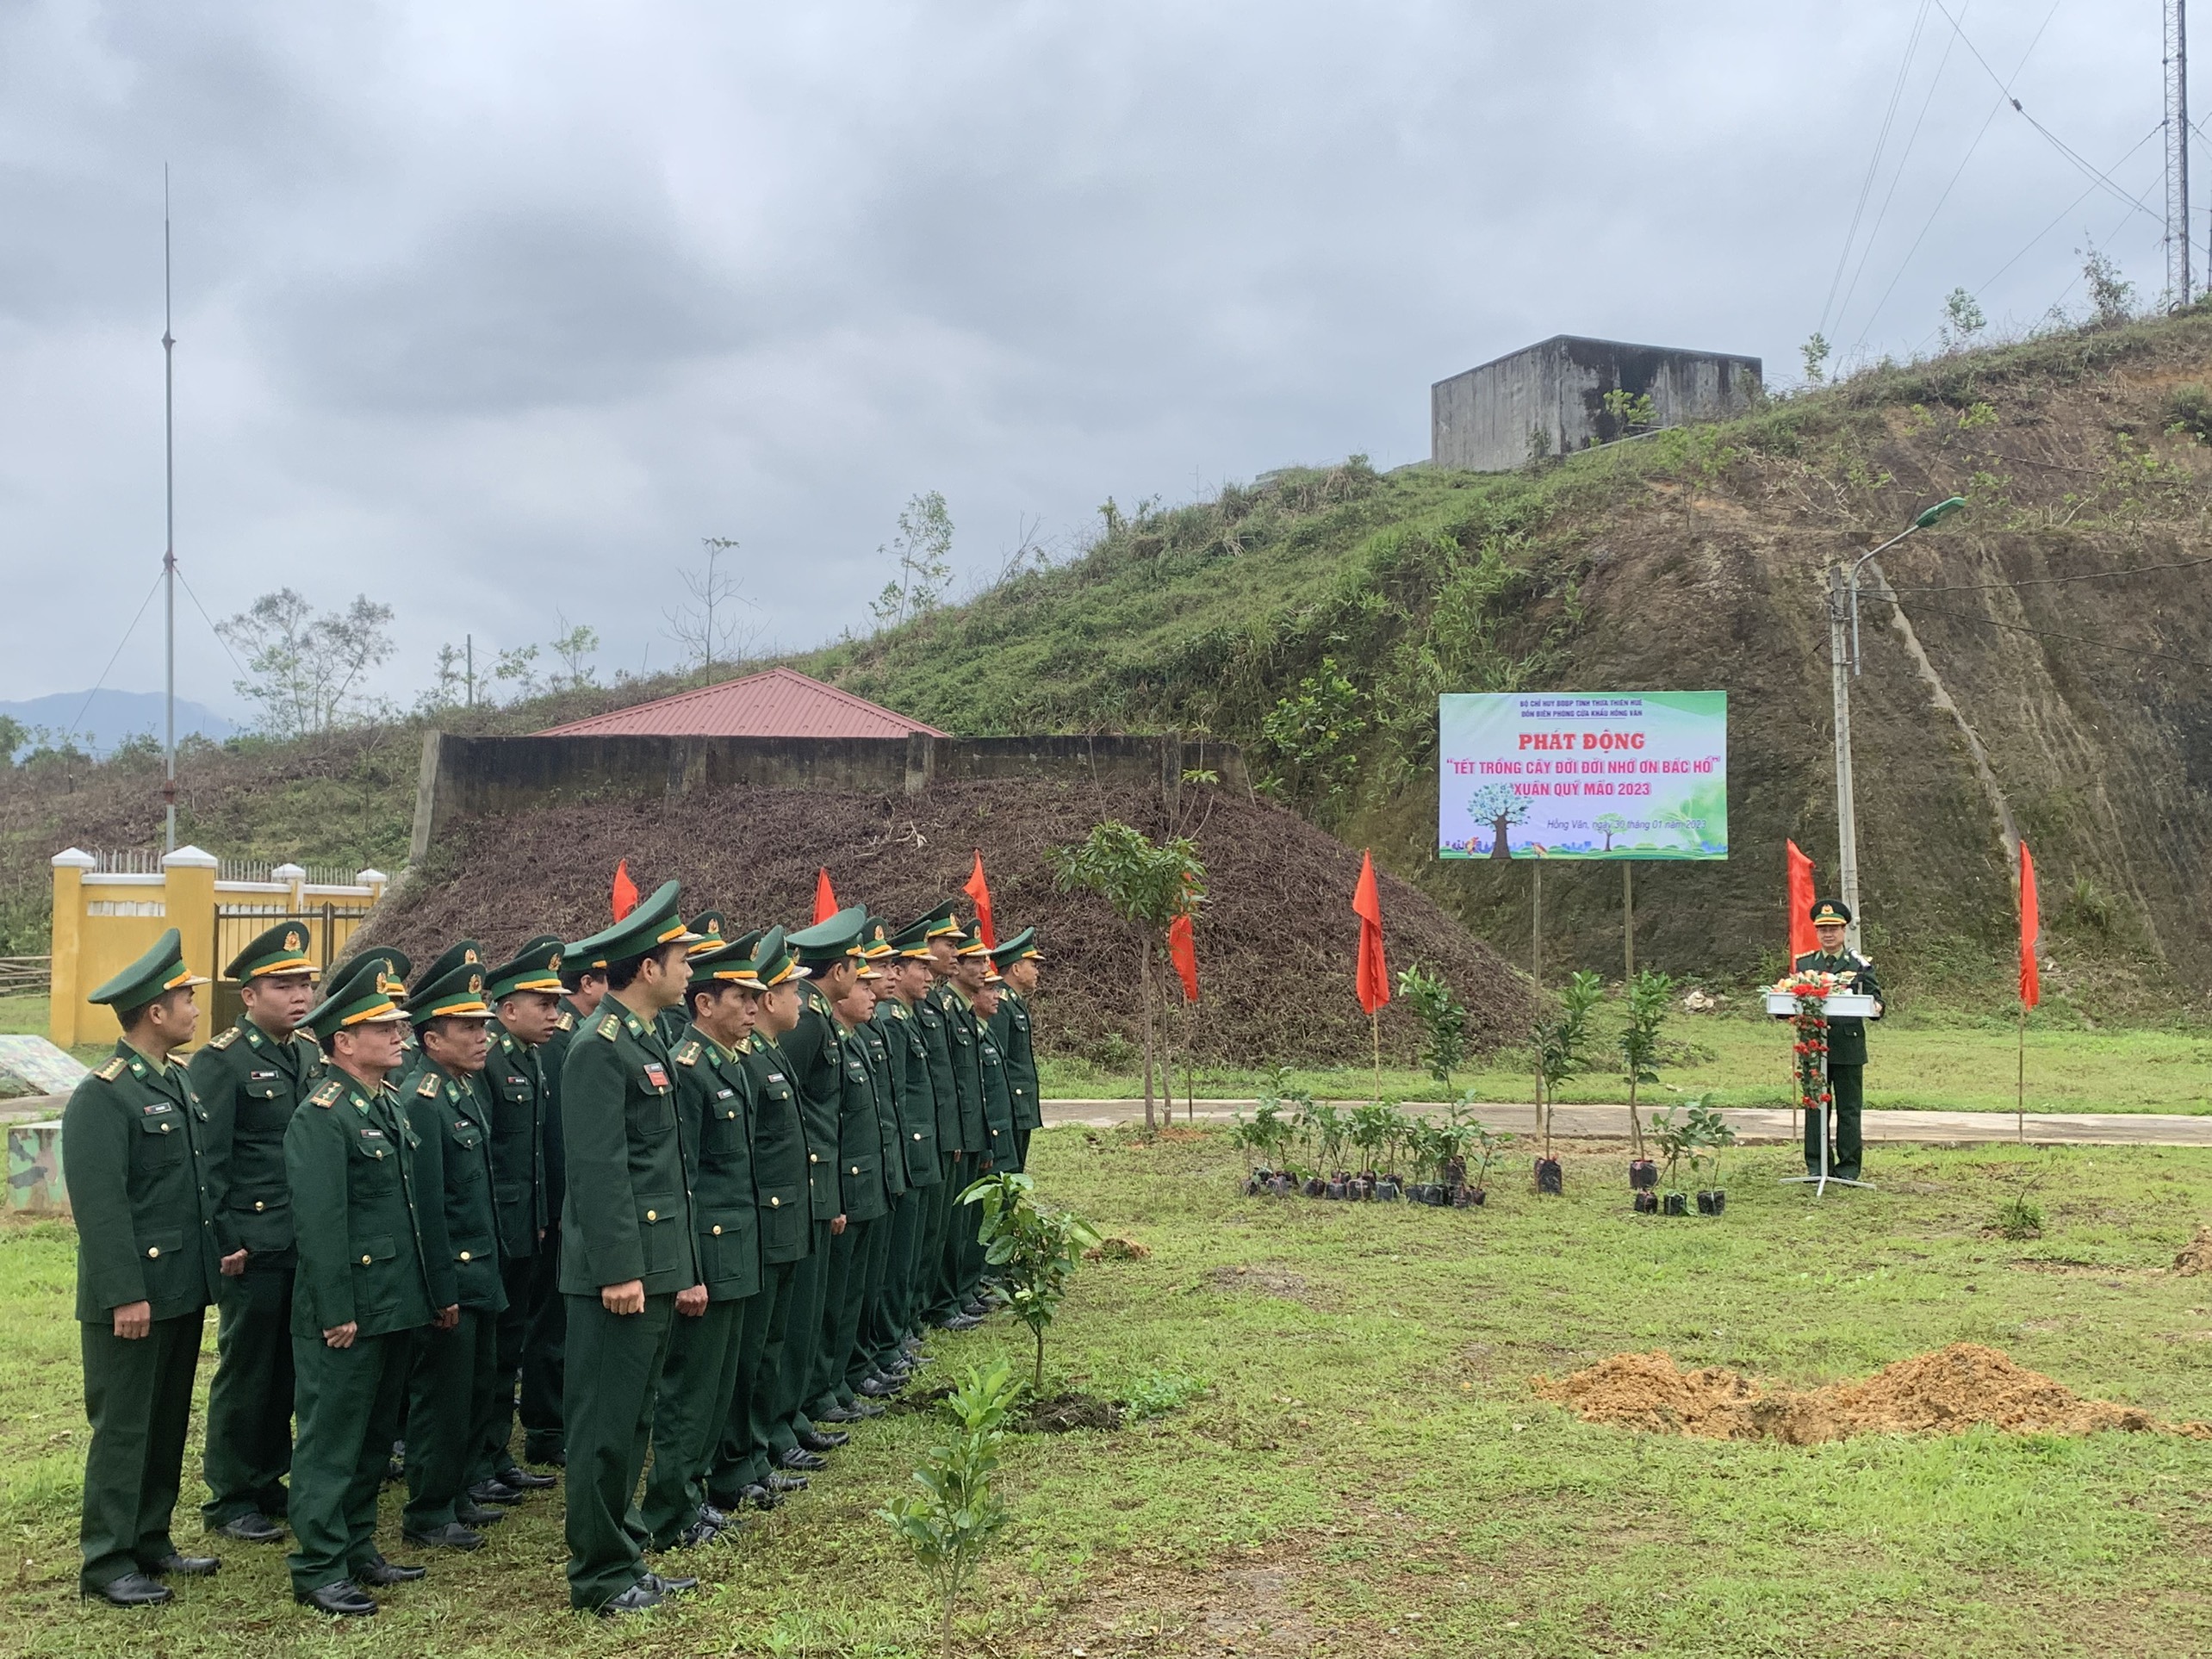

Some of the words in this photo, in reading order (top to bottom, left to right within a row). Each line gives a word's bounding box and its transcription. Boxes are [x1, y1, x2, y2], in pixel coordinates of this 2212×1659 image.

[1519, 728, 1576, 749] PHÁT
[1583, 728, 1644, 754] ĐỘNG
[1619, 782, 1650, 795] 2023
[1651, 820, 1662, 829] 01
